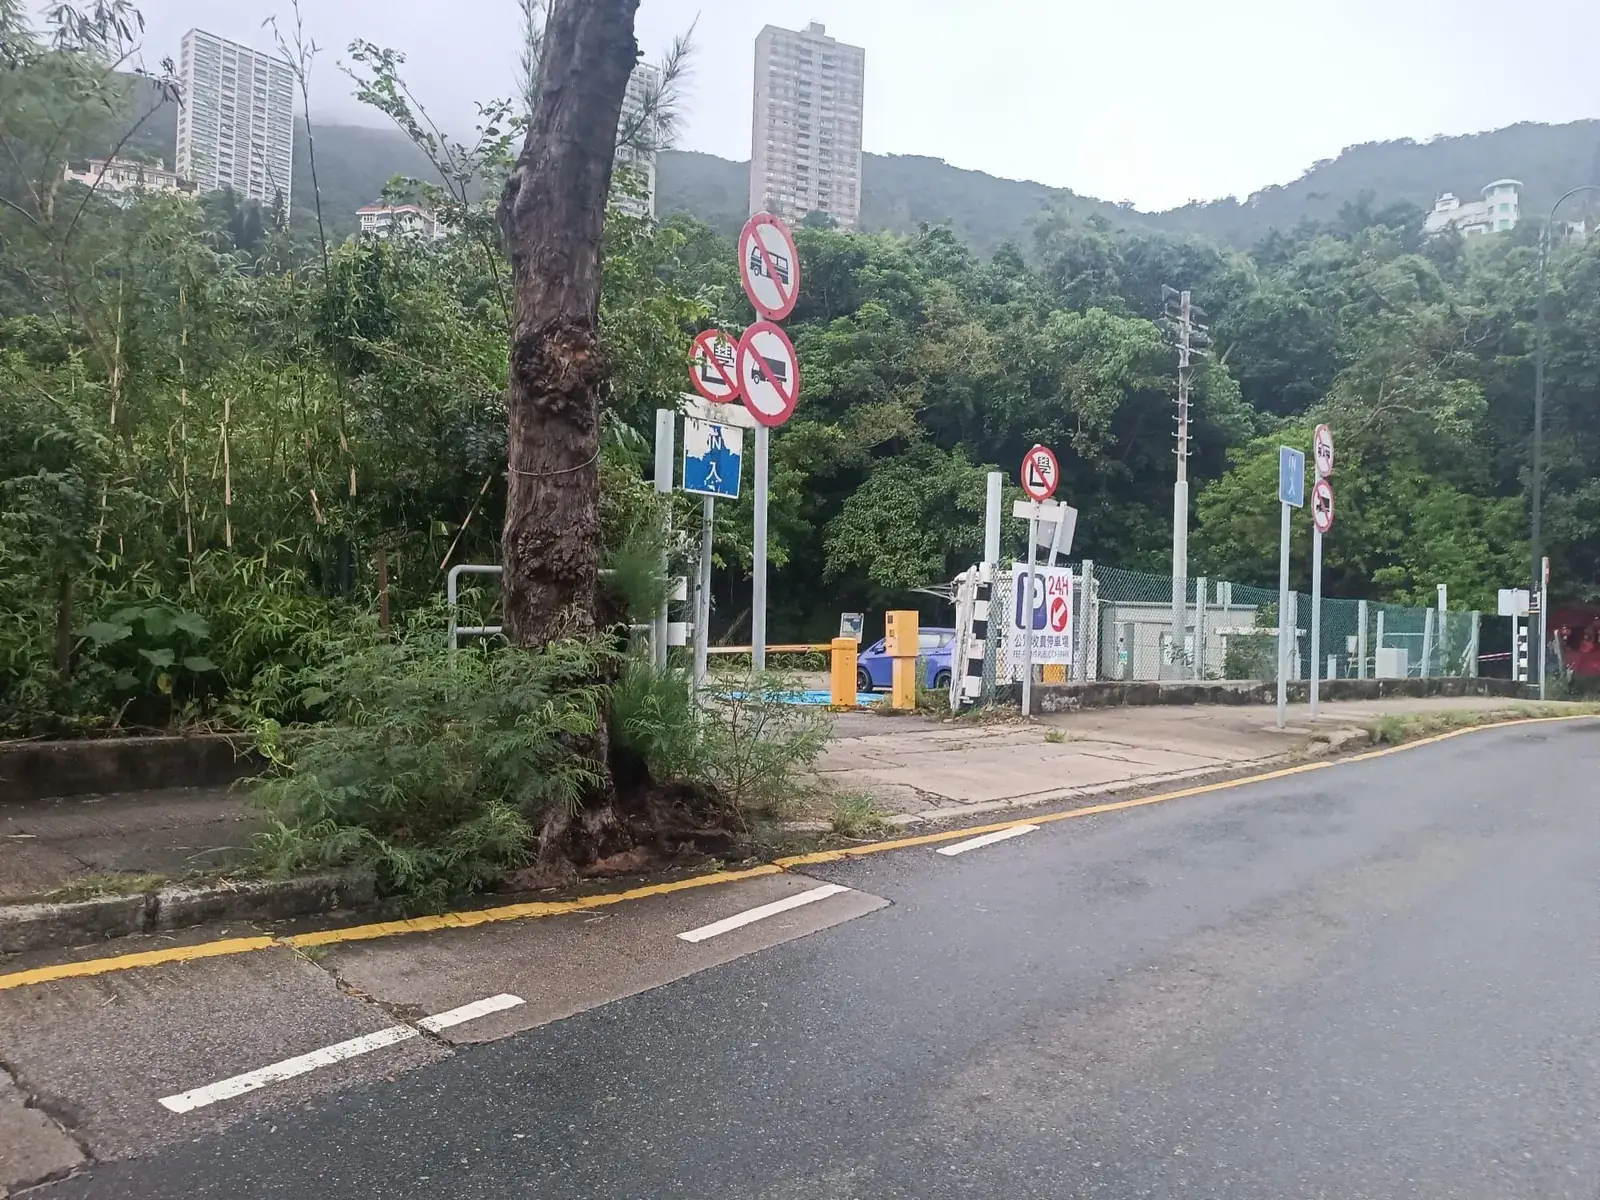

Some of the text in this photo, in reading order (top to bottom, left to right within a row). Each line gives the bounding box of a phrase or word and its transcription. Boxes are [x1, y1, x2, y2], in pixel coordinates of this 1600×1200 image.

[704, 461, 723, 482] 入
[1048, 575, 1069, 596] 24H
[1020, 576, 1044, 627] P
